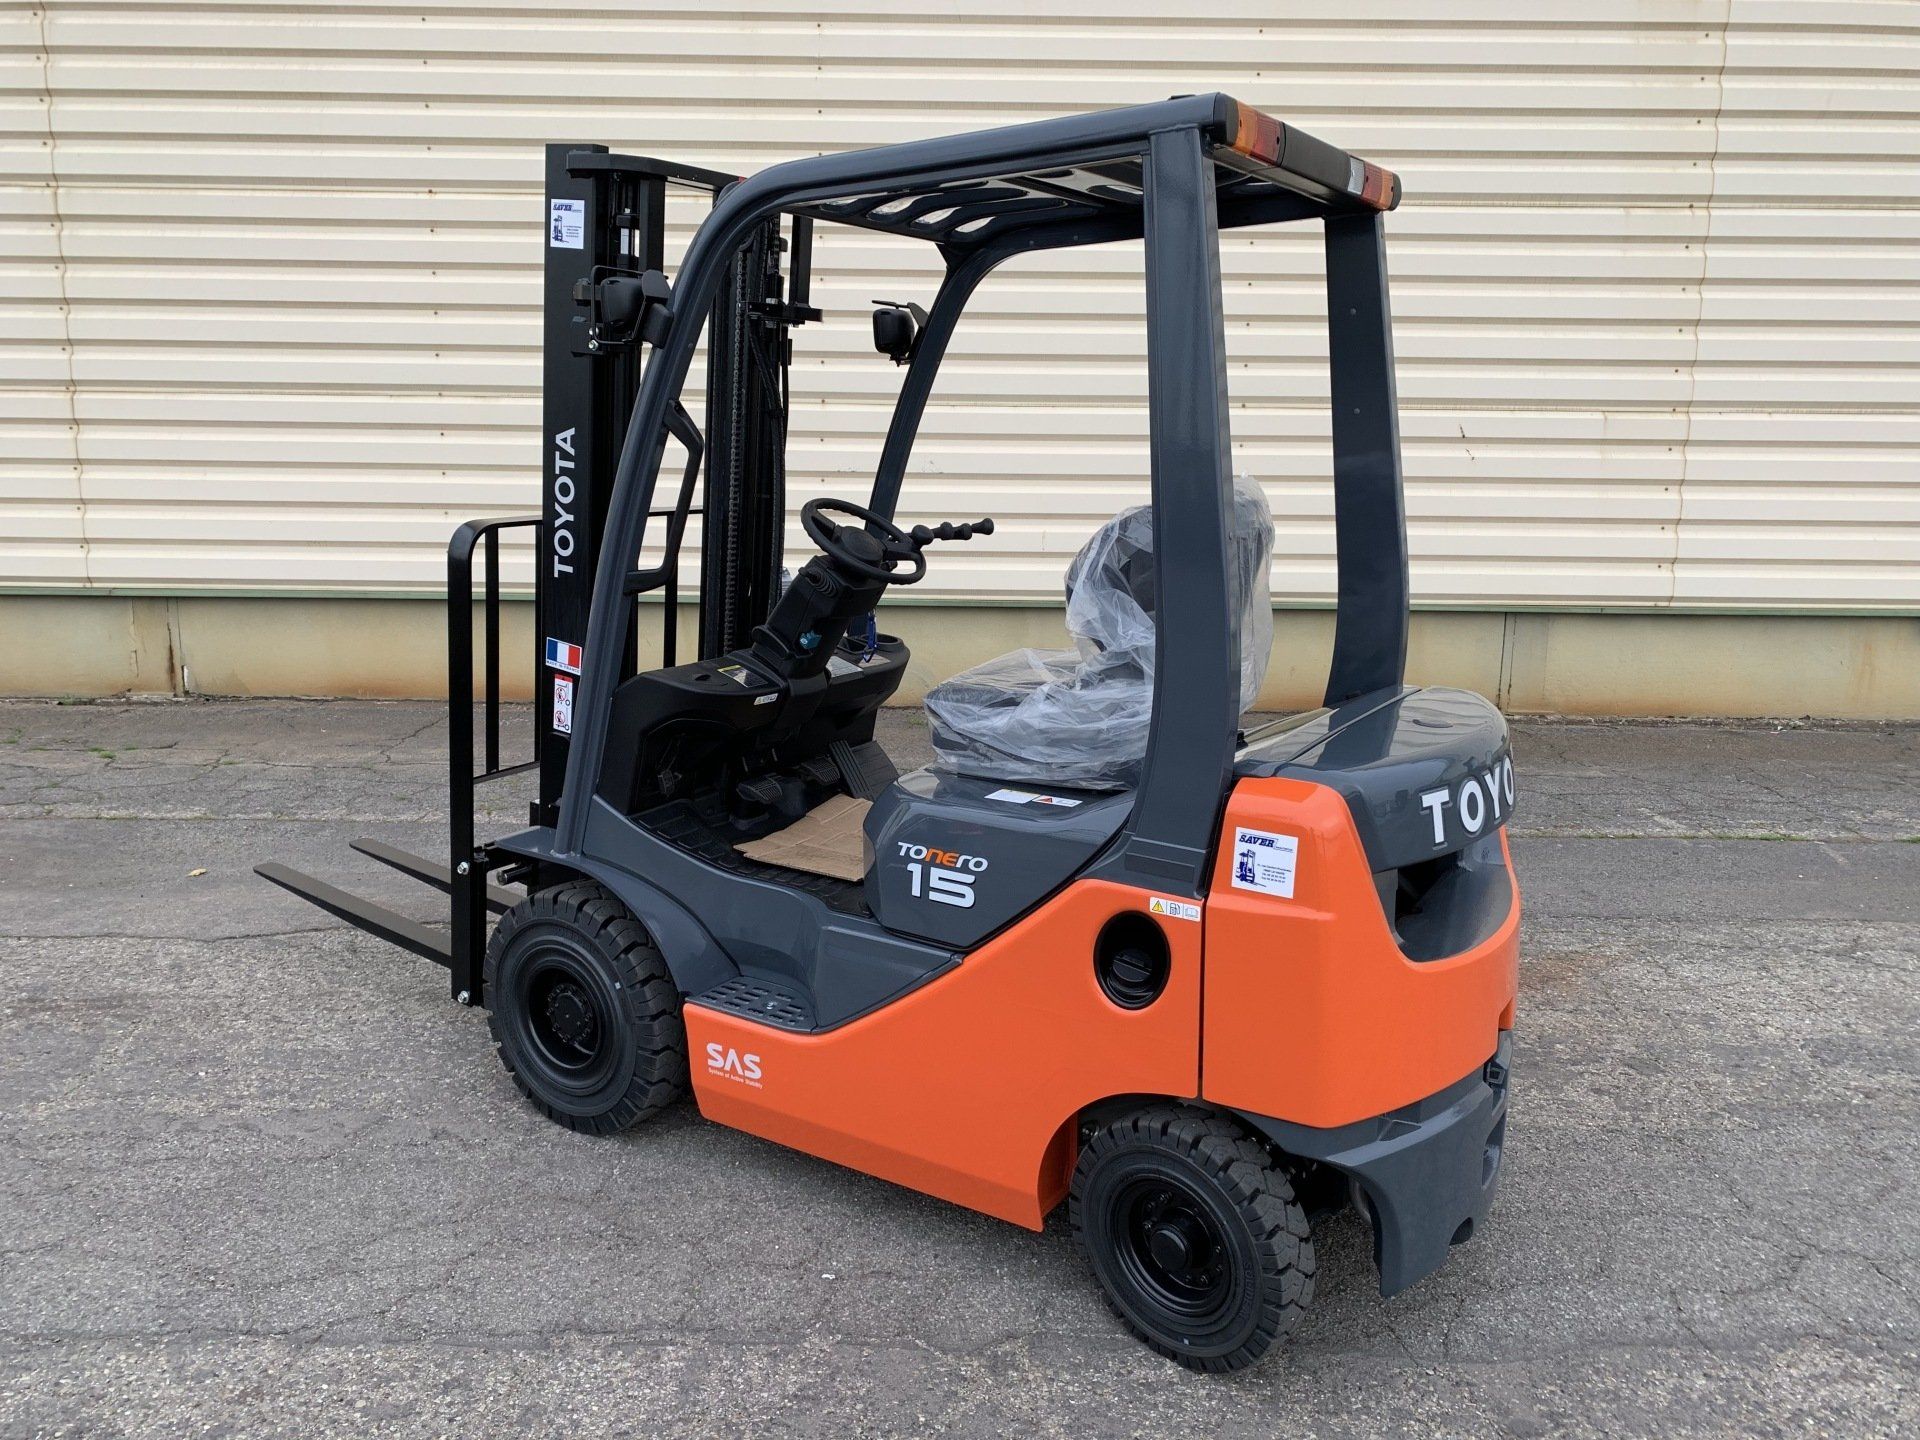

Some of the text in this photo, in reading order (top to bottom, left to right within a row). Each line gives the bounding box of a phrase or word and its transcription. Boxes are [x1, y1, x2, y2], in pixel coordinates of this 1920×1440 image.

[554, 427, 575, 578] TOYOTA
[1239, 834, 1275, 848] SAVER
[906, 862, 976, 908] 15
[706, 1042, 762, 1080] SAS
